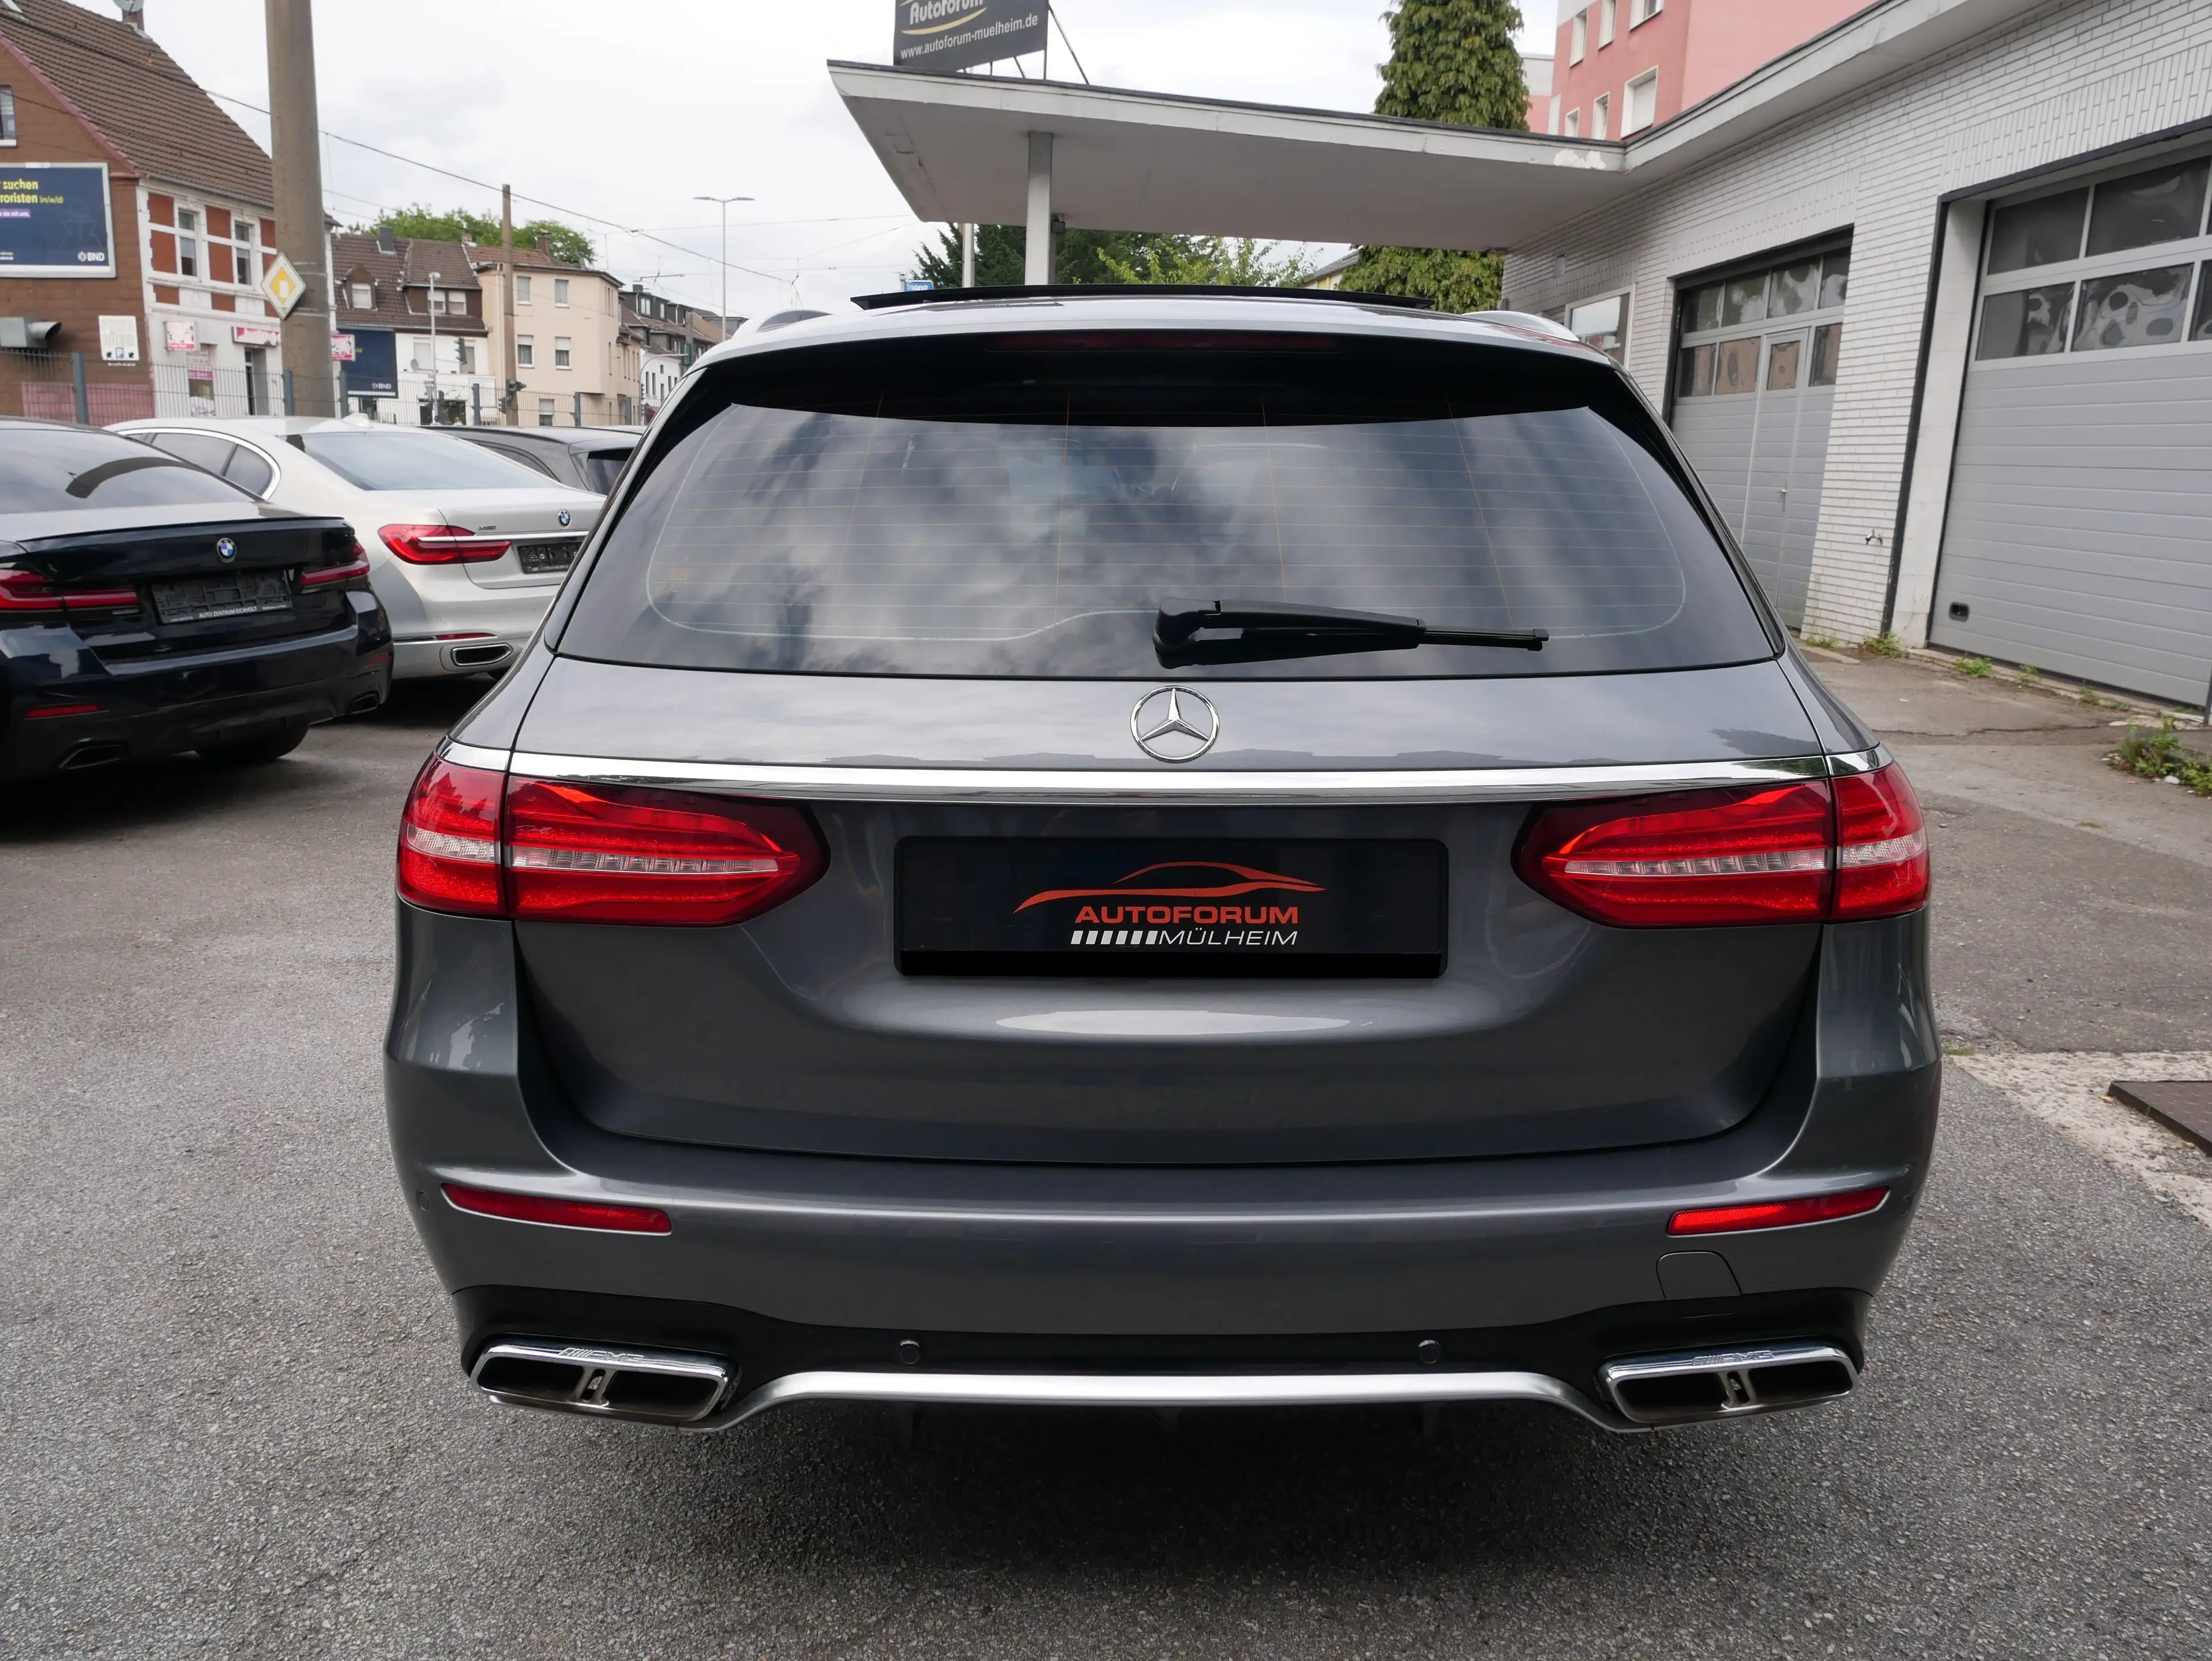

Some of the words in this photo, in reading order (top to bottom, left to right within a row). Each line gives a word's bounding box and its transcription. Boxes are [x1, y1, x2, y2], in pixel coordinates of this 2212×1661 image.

[900, 13, 1038, 59] www.autoforum-muelheim.de
[3, 179, 39, 190] suchen
[87, 252, 104, 261] BND
[1075, 906, 1298, 924] AUTOFORUM
[1159, 927, 1298, 945] MÜLHEIM
